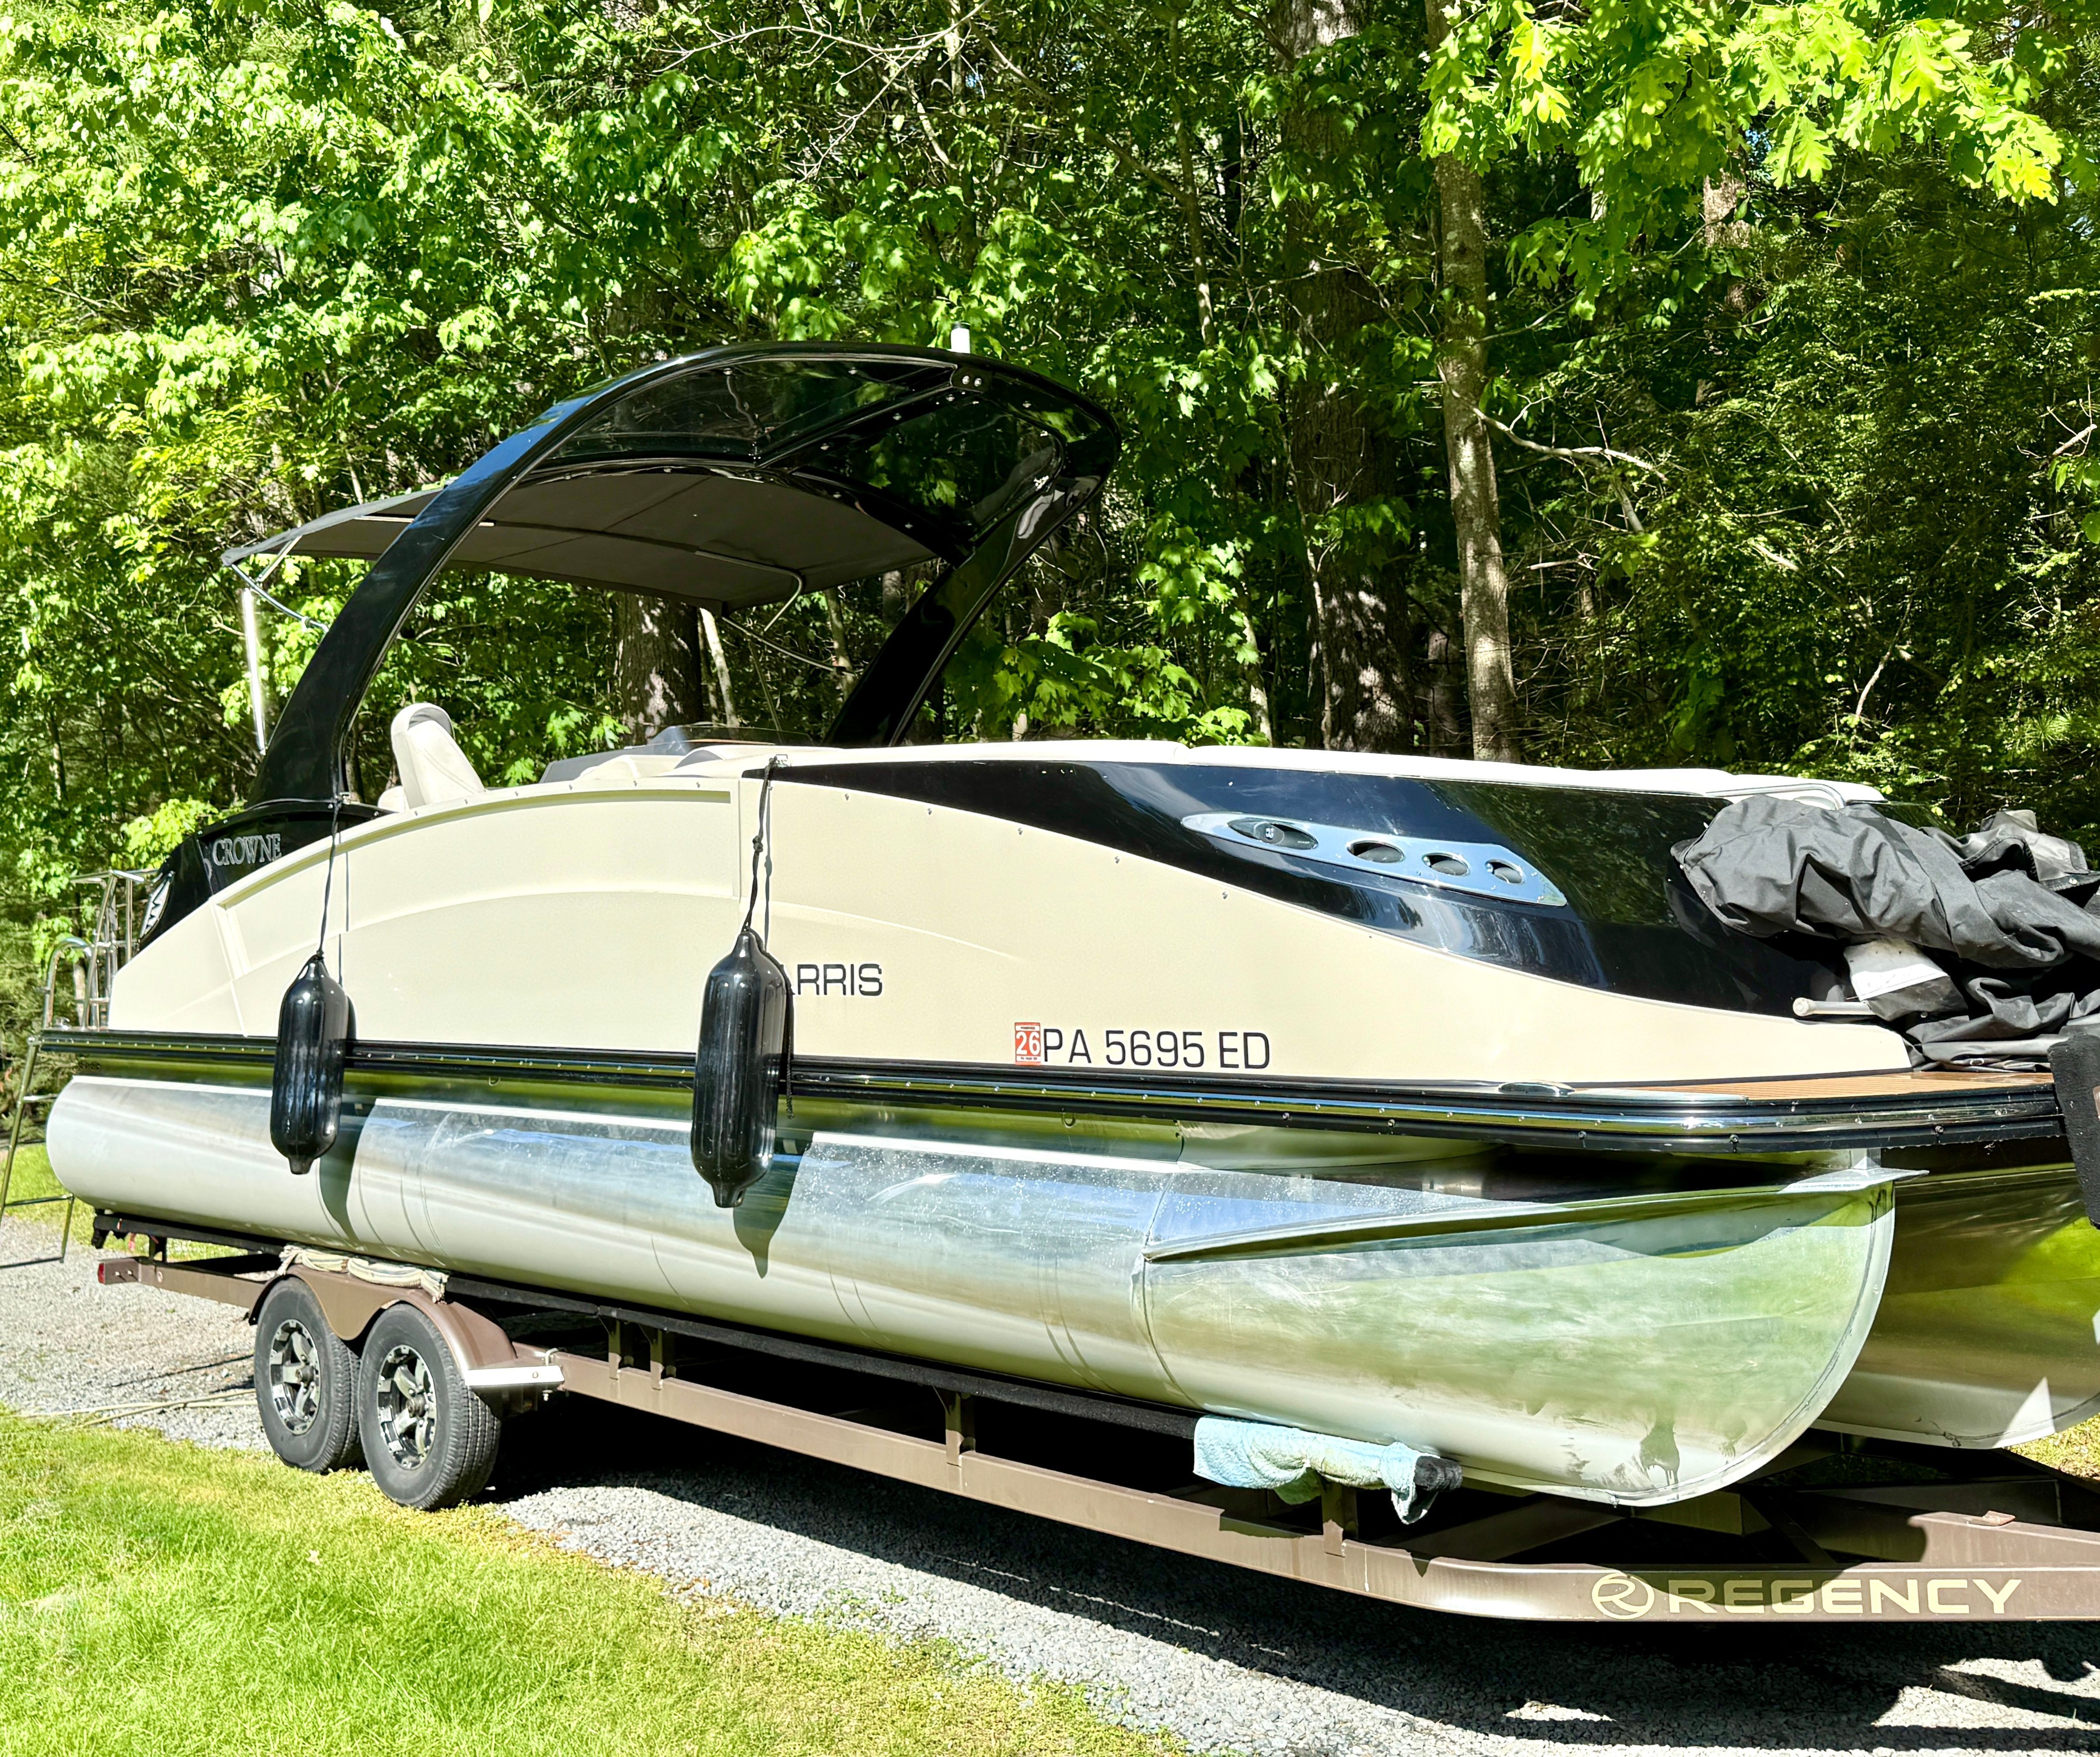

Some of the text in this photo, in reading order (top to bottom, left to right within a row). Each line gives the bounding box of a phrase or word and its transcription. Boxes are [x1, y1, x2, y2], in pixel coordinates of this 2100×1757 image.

[212, 833, 282, 866] CROWNE
[790, 963, 883, 997] RRIS
[1016, 1031, 1040, 1056] 26
[1043, 1028, 1271, 1069] PA 5695 ED
[1668, 1579, 2022, 1614] REGENCY
